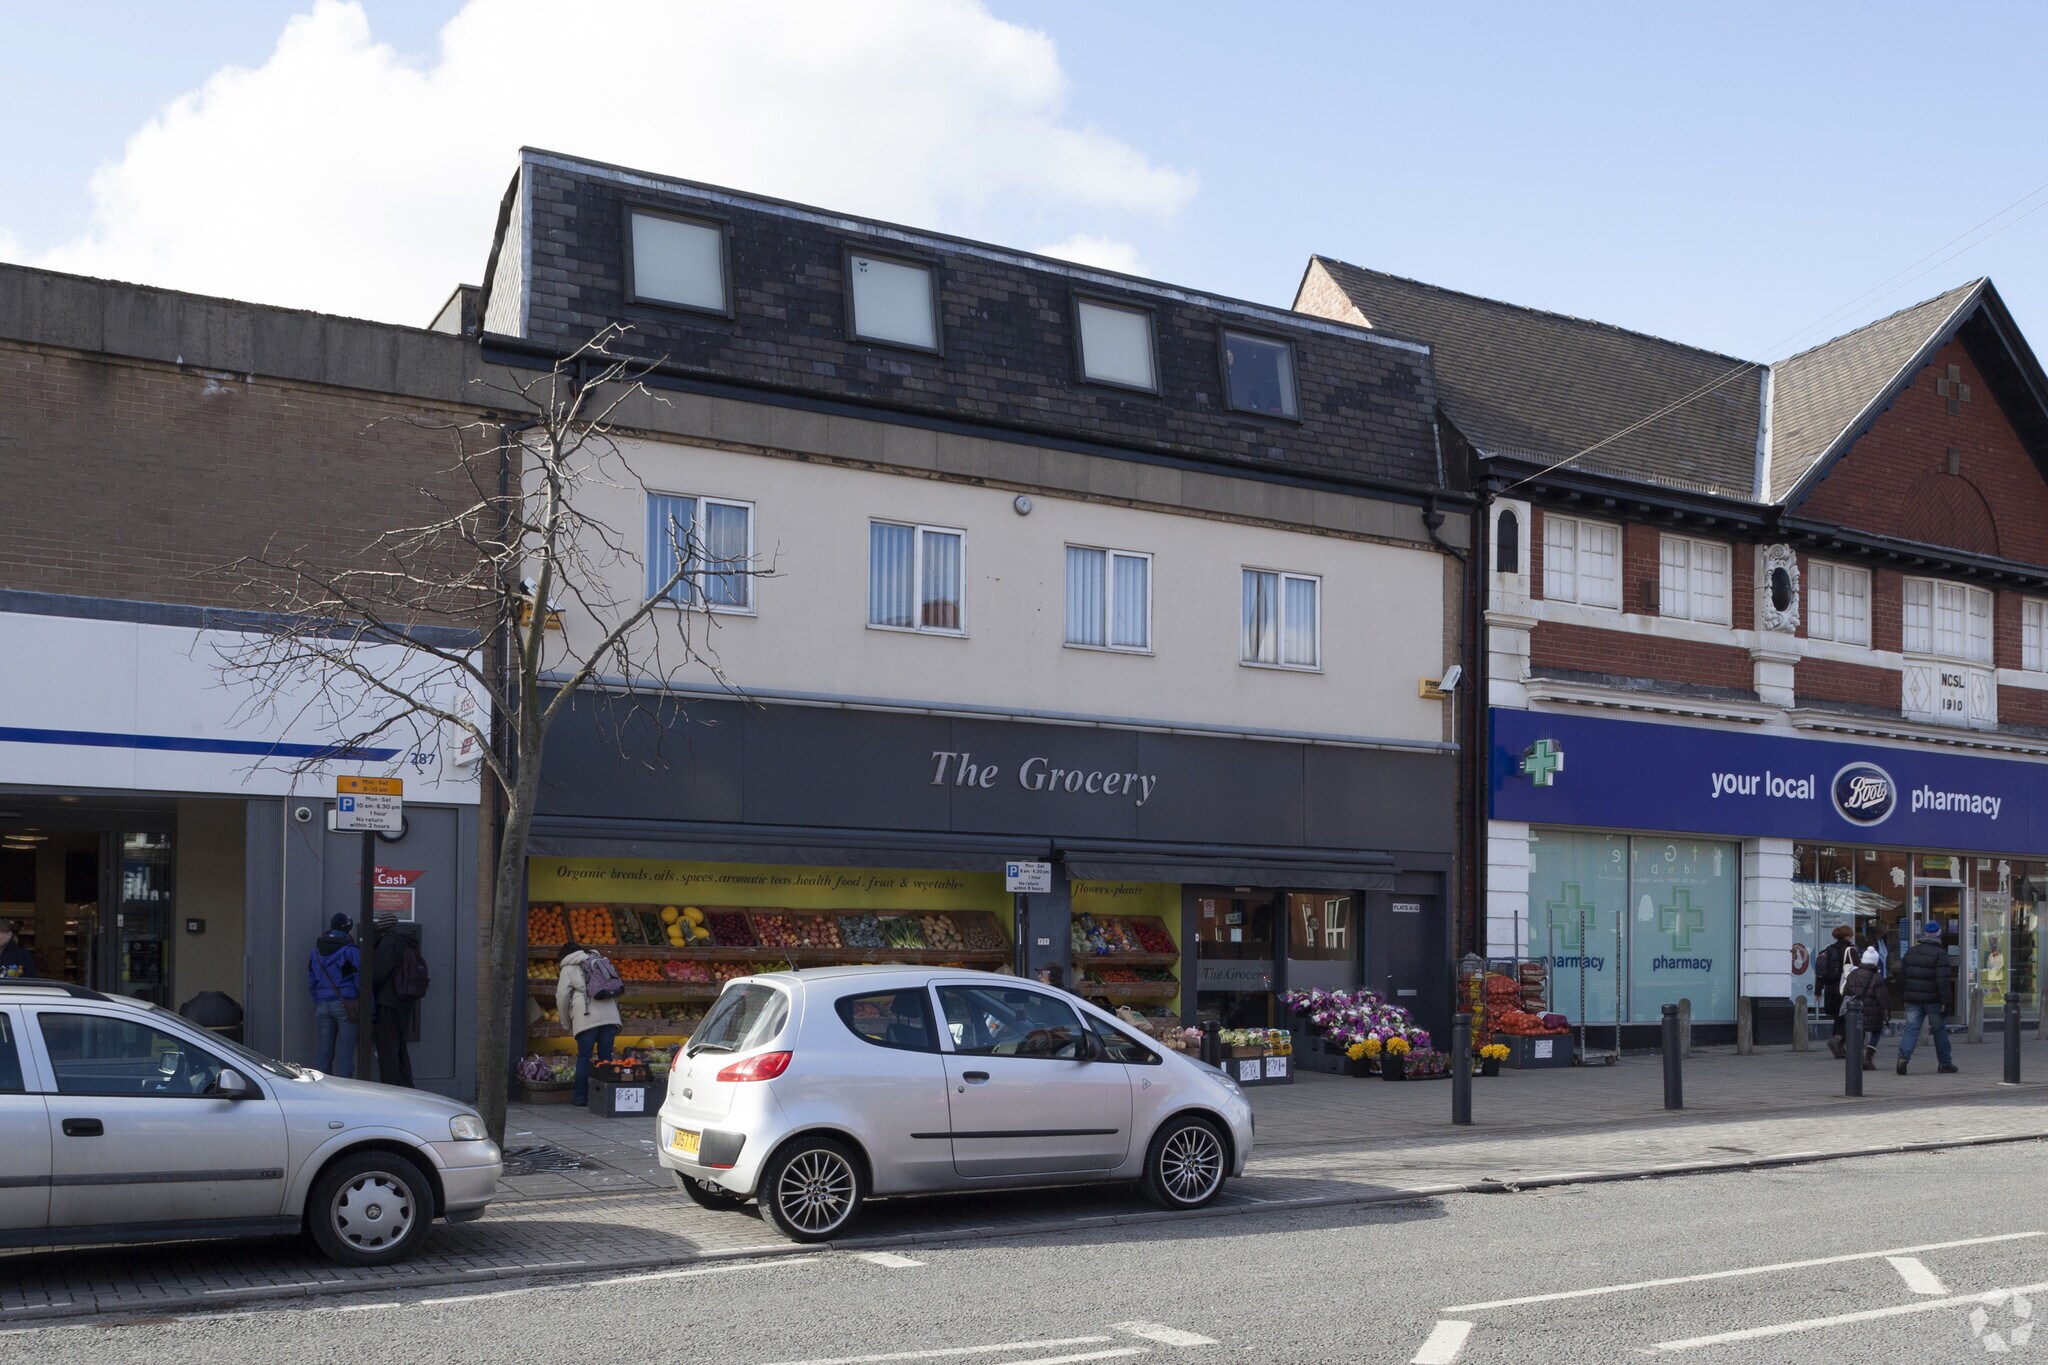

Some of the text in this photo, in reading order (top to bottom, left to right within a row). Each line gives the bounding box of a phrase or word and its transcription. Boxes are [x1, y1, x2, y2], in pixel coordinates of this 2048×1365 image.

[1942, 673, 1965, 688] NCSL
[1942, 698, 1963, 711] 1910
[410, 753, 436, 765] 287
[929, 751, 1157, 807] The Grocery
[1711, 770, 1815, 799] your local
[1844, 776, 1888, 809] Boots
[1912, 784, 2001, 820] pharmacy
[377, 873, 407, 885] Cash
[556, 865, 607, 881] Organic
[719, 872, 768, 885] aromatic
[796, 874, 831, 886] health
[865, 876, 894, 891] fruit
[899, 877, 909, 888] &
[914, 878, 964, 892] vegetables
[1652, 954, 1713, 972] pharmacy
[1203, 967, 1223, 980] The
